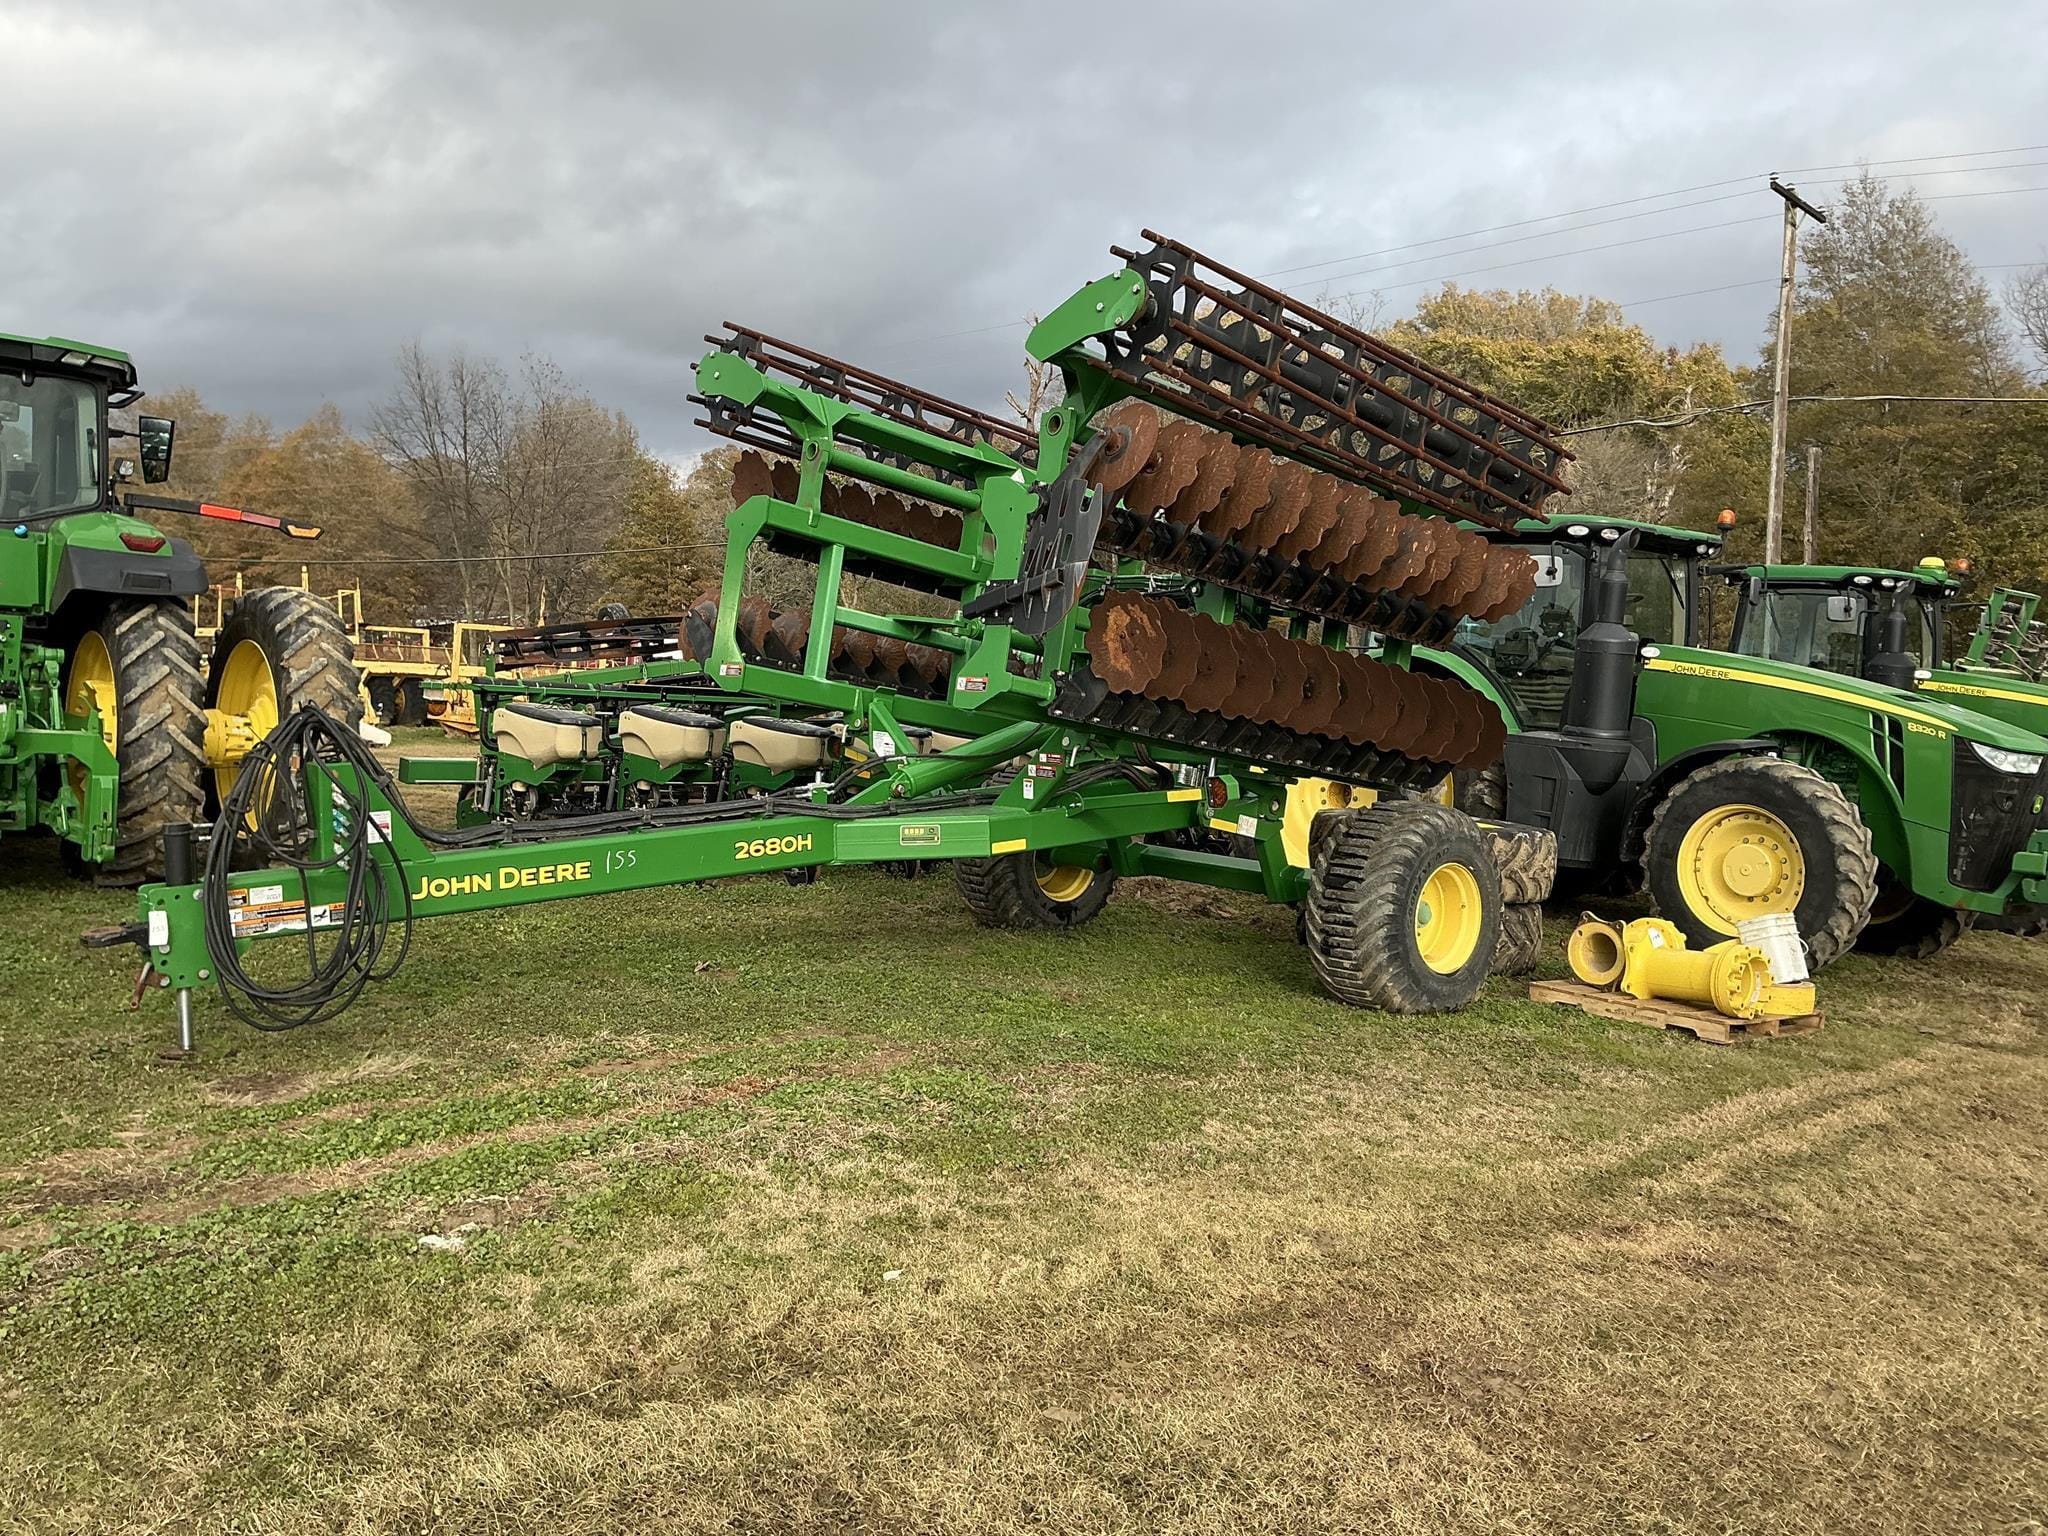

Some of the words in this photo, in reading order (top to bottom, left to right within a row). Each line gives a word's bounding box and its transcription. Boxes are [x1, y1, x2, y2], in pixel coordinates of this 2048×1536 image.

[1671, 663, 1697, 675] JOHN
[1698, 666, 1731, 679] DEERE
[1936, 684, 1958, 693] JOHN
[1959, 686, 1988, 696] DEERE
[1907, 722, 1936, 736] 8320
[1937, 730, 1946, 740] R
[734, 833, 813, 860] 2680H
[606, 849, 637, 874] 155
[411, 872, 492, 901] JOHN
[499, 860, 592, 890] DEERE
